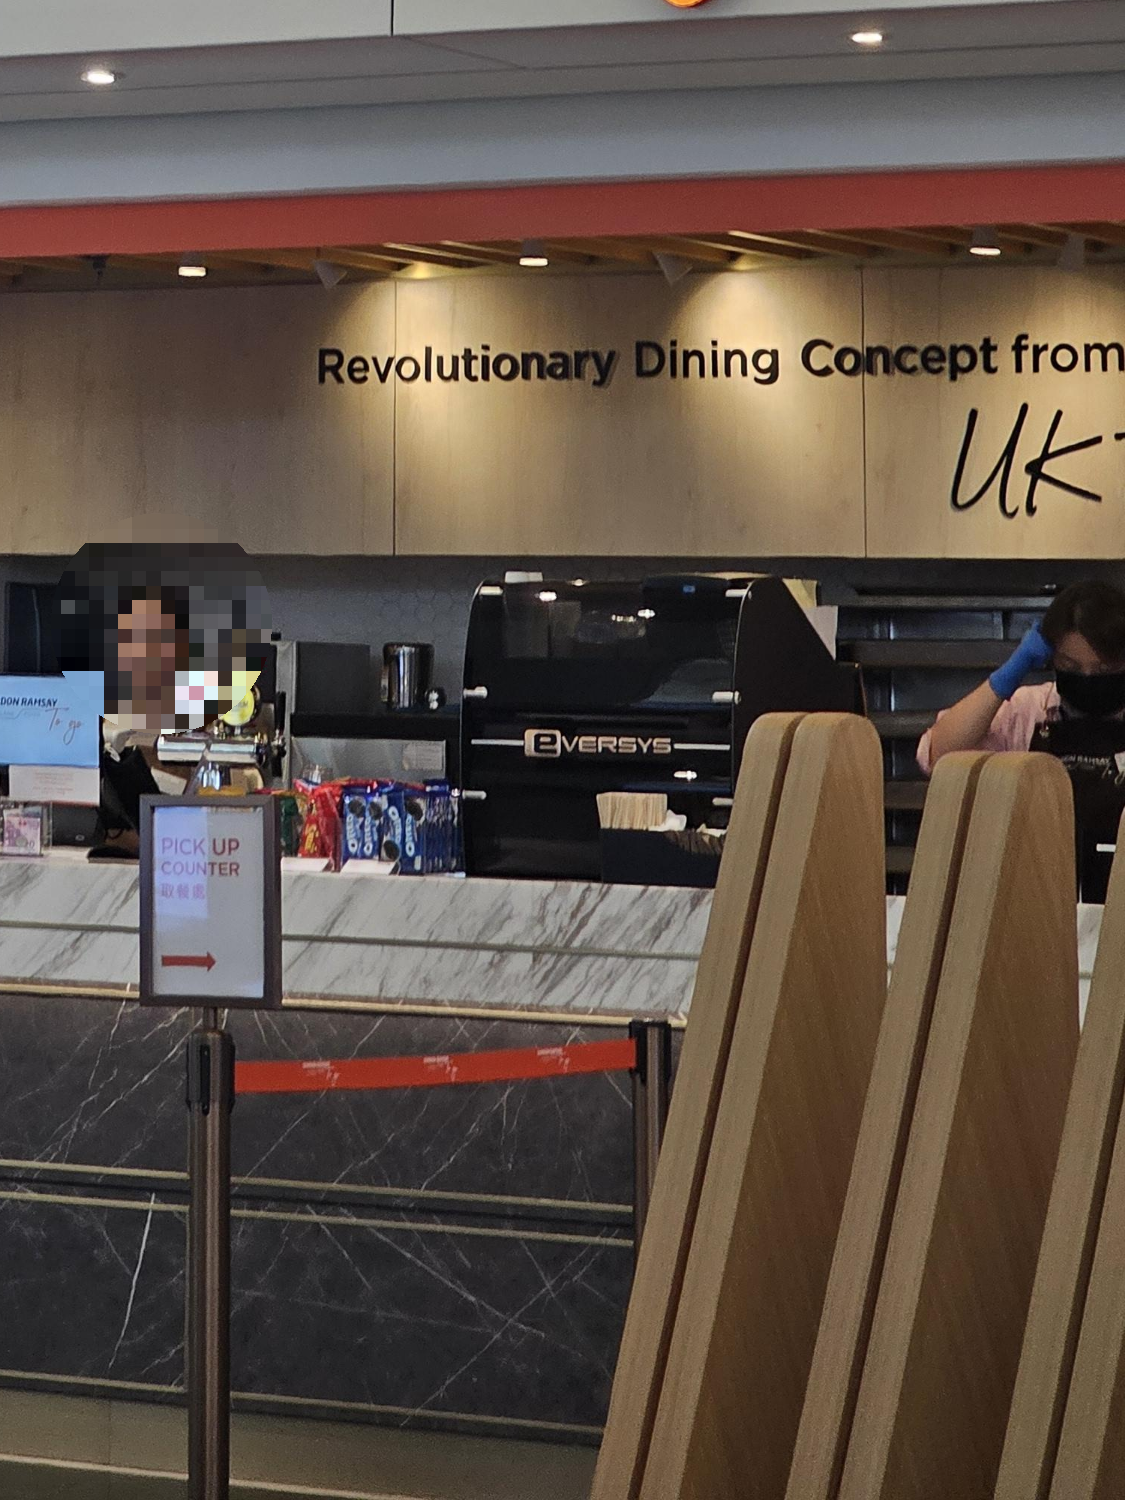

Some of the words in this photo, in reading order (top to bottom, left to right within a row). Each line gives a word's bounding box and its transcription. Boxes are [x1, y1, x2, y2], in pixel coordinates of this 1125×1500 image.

[317, 344, 616, 386] Revolutionary
[634, 338, 781, 385] Dining
[800, 335, 999, 382] Concept
[1011, 333, 1125, 374] from
[20, 697, 58, 708] RAMSAY
[44, 706, 70, 731] To
[63, 719, 83, 745] go
[161, 837, 207, 856] PICK
[212, 838, 240, 856] UP
[160, 860, 240, 877] COUNTER
